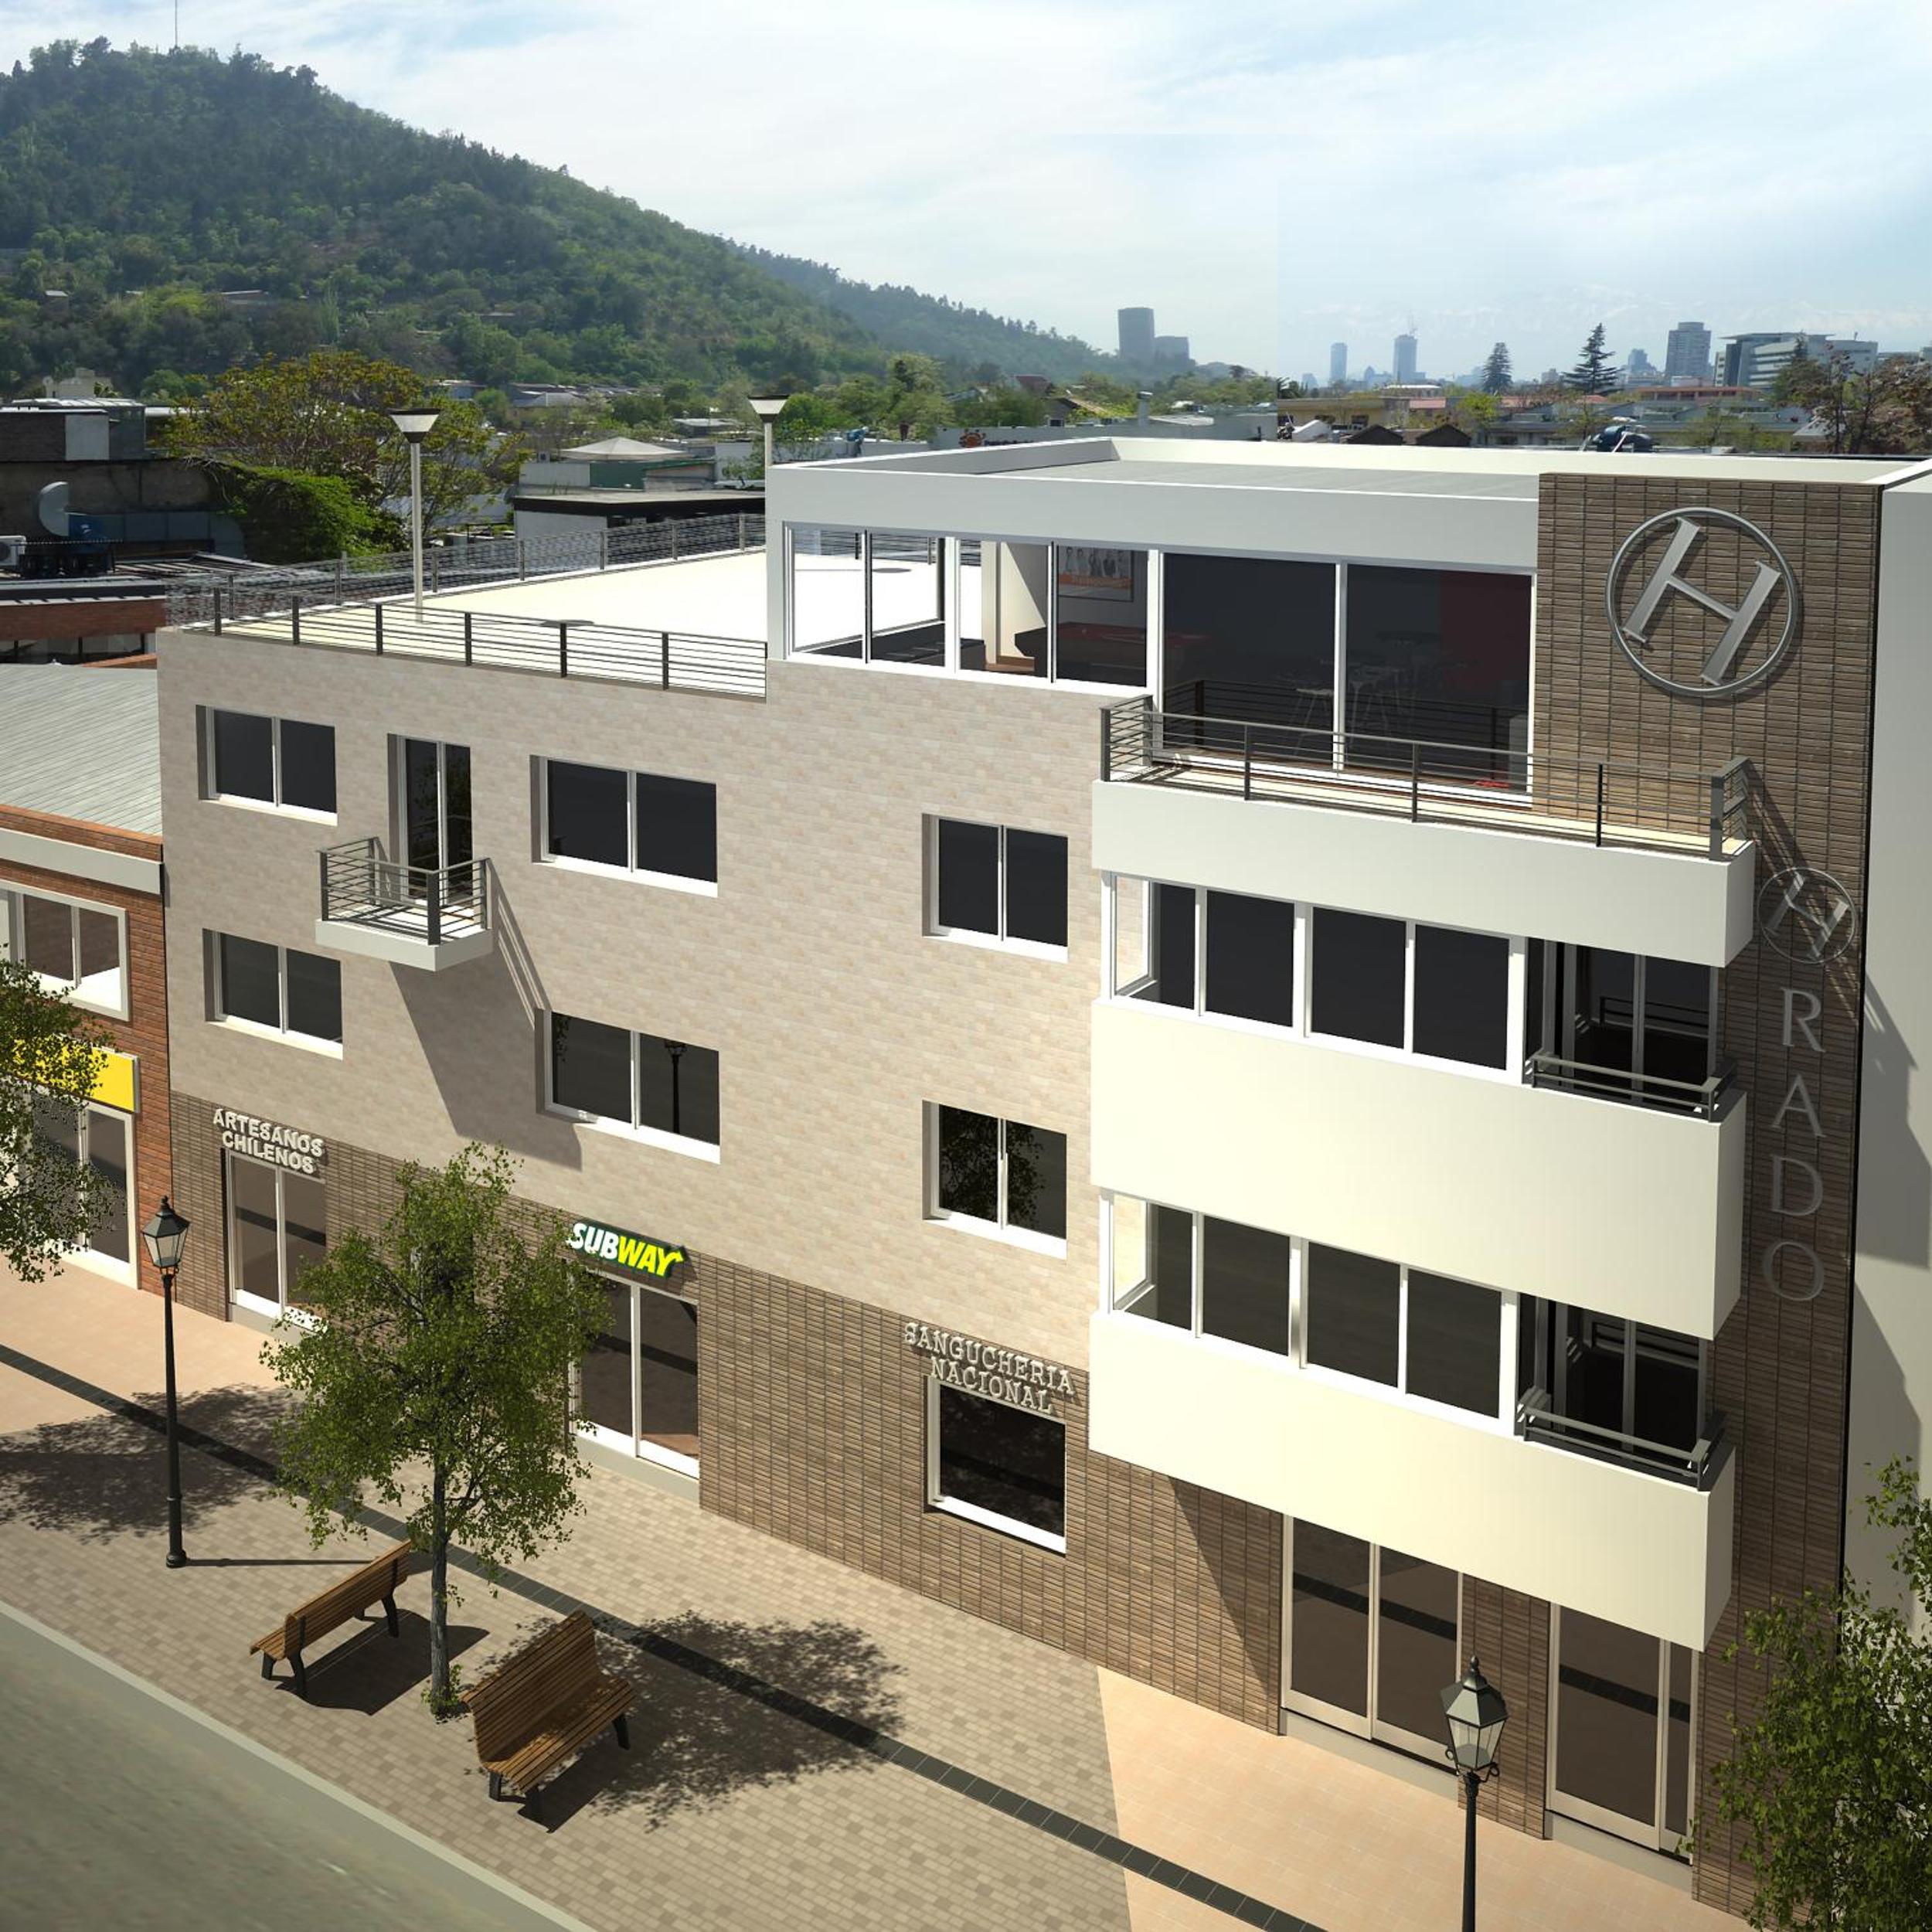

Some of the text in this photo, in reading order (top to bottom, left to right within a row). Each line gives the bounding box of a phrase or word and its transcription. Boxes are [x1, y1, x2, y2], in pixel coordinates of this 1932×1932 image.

[213, 1108, 325, 1158] ARTESANOS
[222, 1131, 316, 1175] CHILENOS
[566, 1222, 685, 1277] SUBWAY
[903, 1322, 1076, 1395] SANGUCHERIA
[930, 1356, 1053, 1414] NACIONAL
